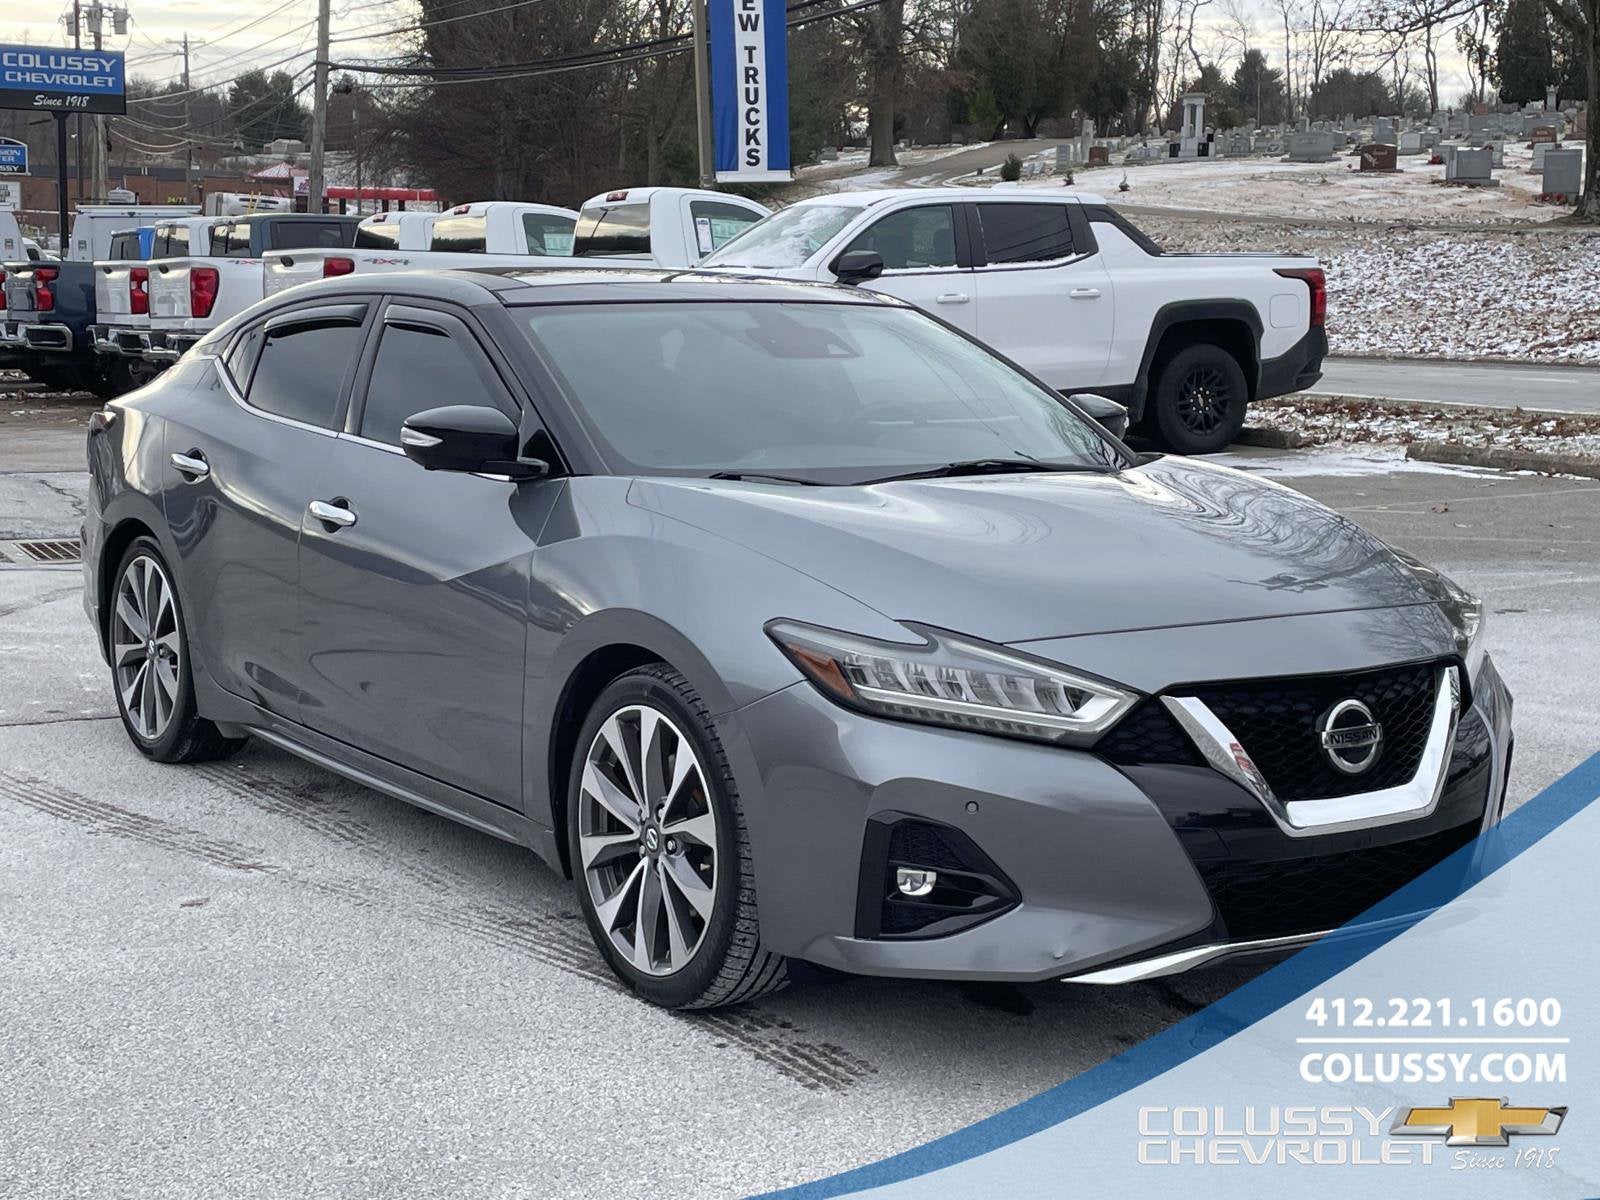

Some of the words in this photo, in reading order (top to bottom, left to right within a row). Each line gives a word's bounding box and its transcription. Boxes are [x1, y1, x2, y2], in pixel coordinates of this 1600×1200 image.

[3, 52, 116, 72] COLUSSY
[5, 71, 116, 87] CHEVROLET
[33, 94, 62, 106] Since
[65, 96, 90, 107] 1918
[744, 46, 761, 166] TRUCKS
[1329, 728, 1377, 746] NISSAN
